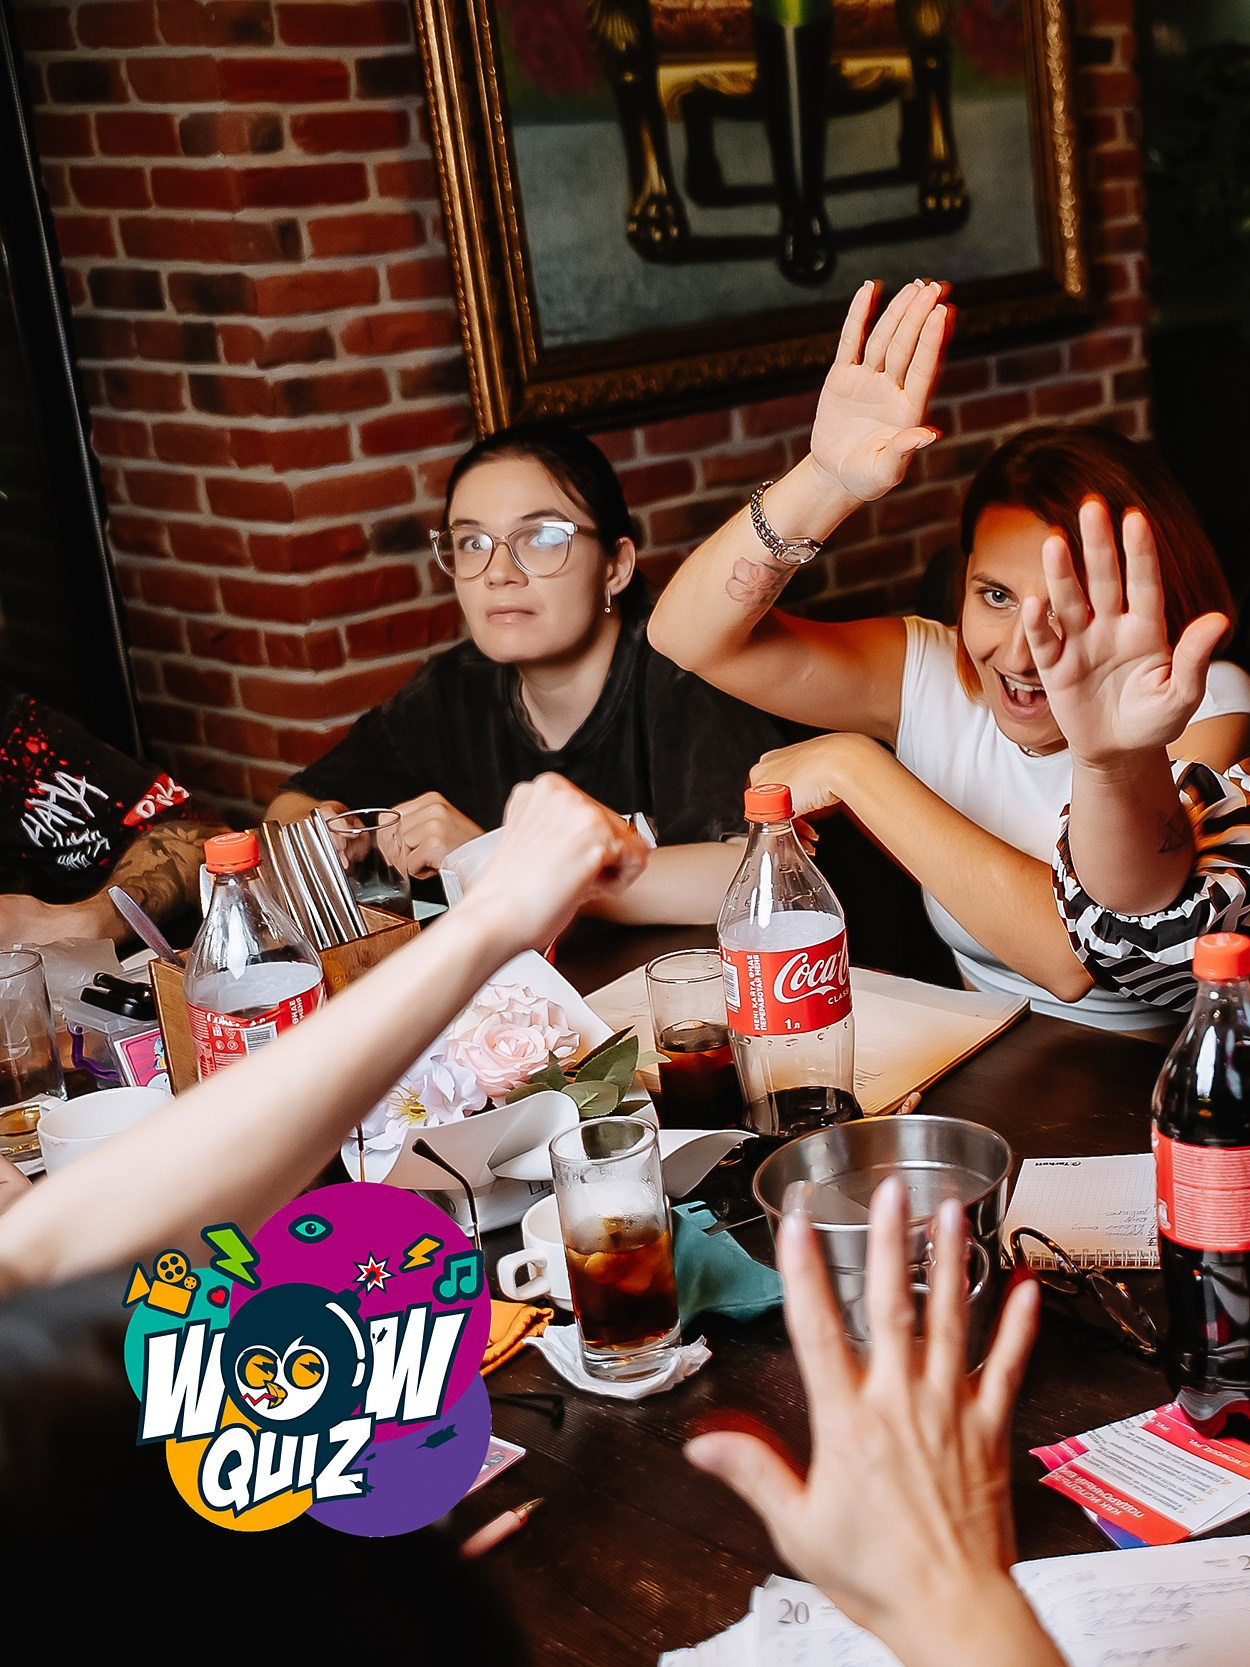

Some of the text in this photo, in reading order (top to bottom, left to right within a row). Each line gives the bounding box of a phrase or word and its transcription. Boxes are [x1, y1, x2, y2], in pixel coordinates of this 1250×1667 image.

[753, 954, 762, 976] МЕНЯ
[1048, 1471, 1102, 1505] ИСПОЛЬЗО
[777, 1597, 811, 1625] 20
